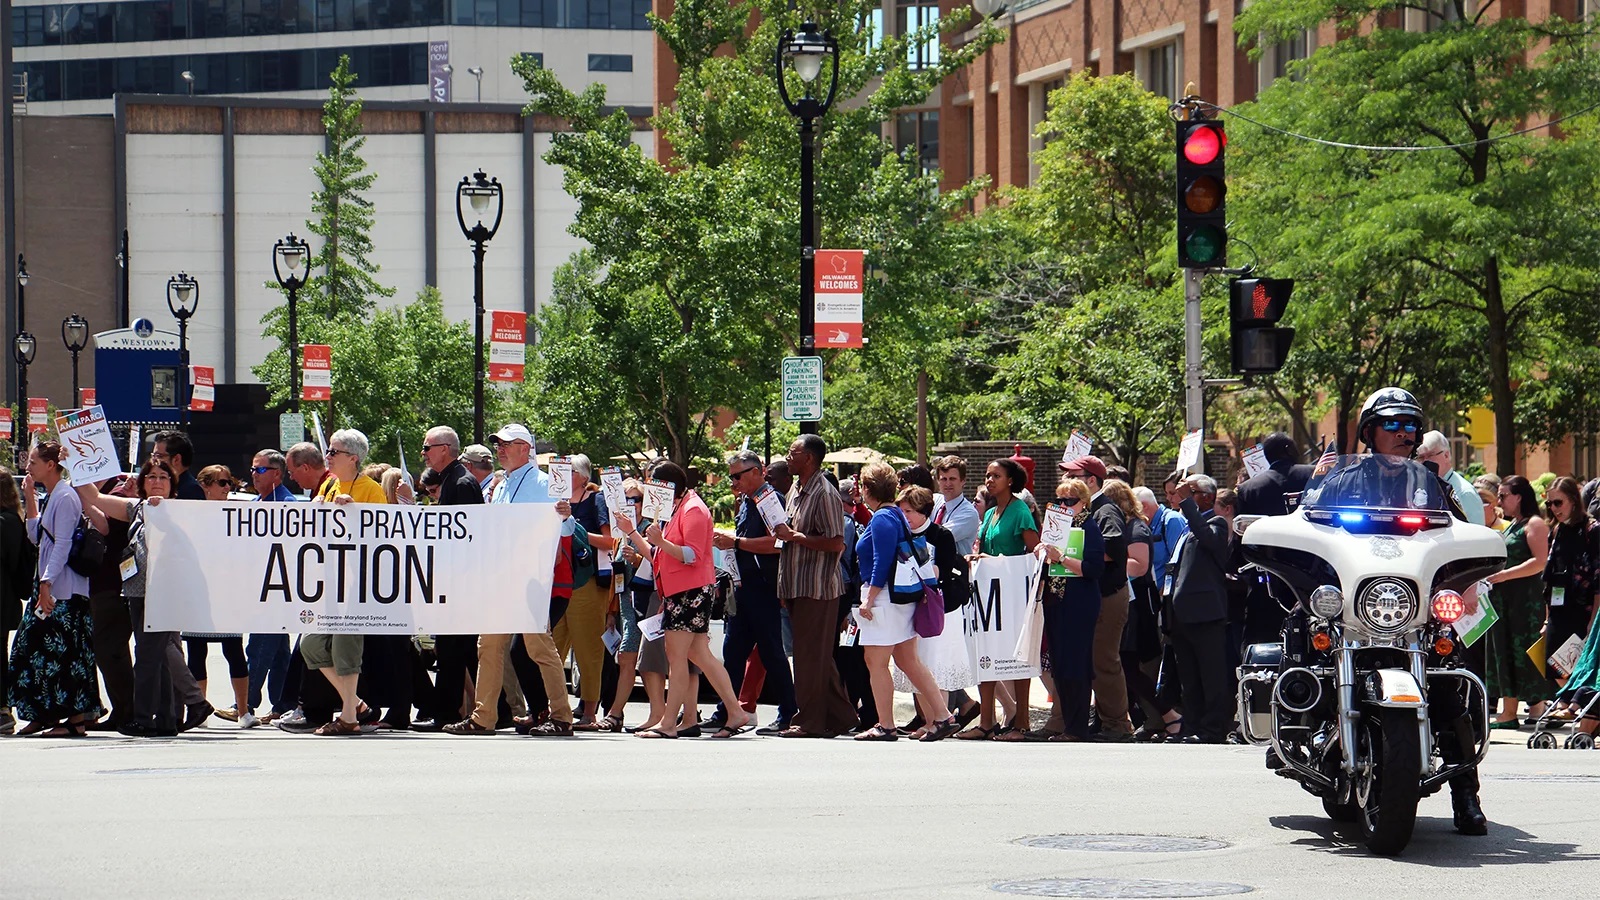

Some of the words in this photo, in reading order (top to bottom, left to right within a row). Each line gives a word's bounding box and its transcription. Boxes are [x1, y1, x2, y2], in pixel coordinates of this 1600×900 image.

[431, 43, 447, 52] rent
[431, 53, 447, 61] now
[820, 281, 858, 289] WELCOMES
[121, 338, 167, 346] WESTOWN
[785, 363, 790, 374] 2
[786, 387, 792, 400] 2
[60, 412, 102, 431] AMMPARO
[222, 507, 352, 541] THOUGHTS,
[360, 509, 473, 542] PRAYERS,
[260, 543, 447, 604] ACTION.
